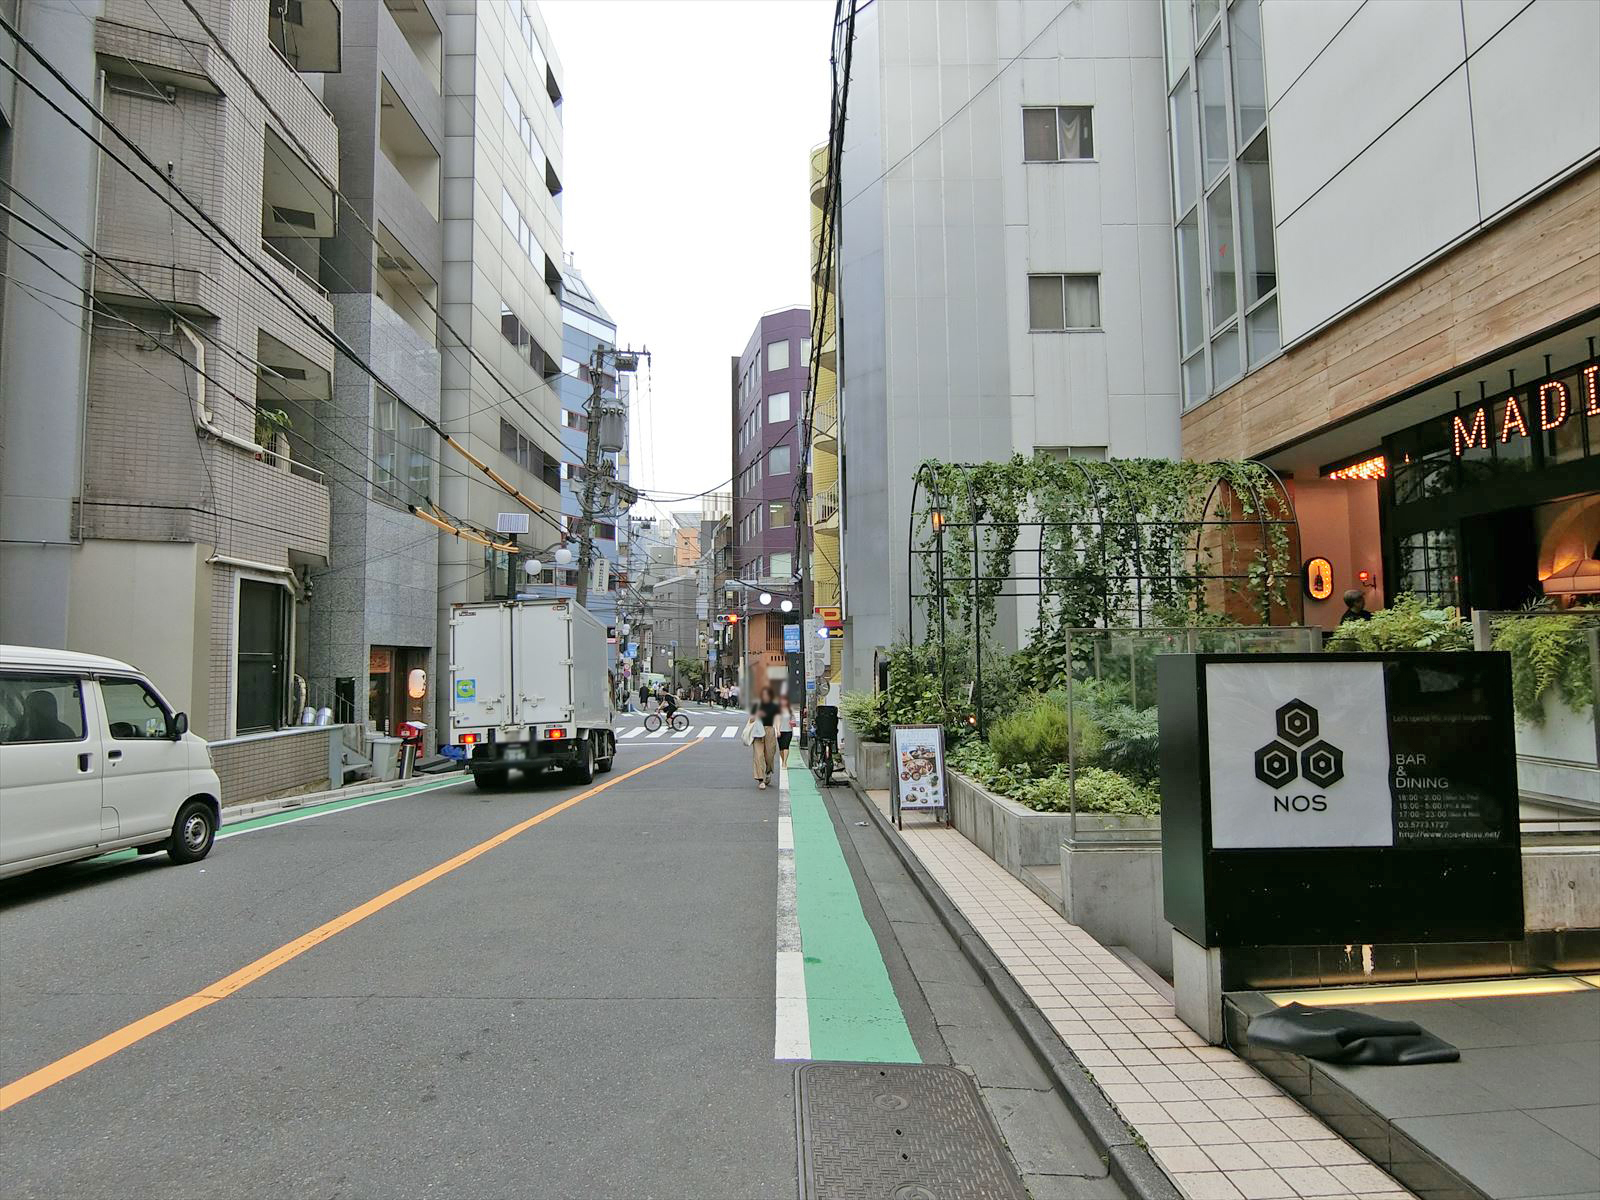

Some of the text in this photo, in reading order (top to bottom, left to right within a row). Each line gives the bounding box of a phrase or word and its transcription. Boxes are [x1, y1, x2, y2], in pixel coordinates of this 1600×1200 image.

[1396, 754, 1426, 765] BAR
[1396, 766, 1407, 777] &
[1395, 777, 1449, 789] DINING
[1274, 795, 1328, 812] NOS
